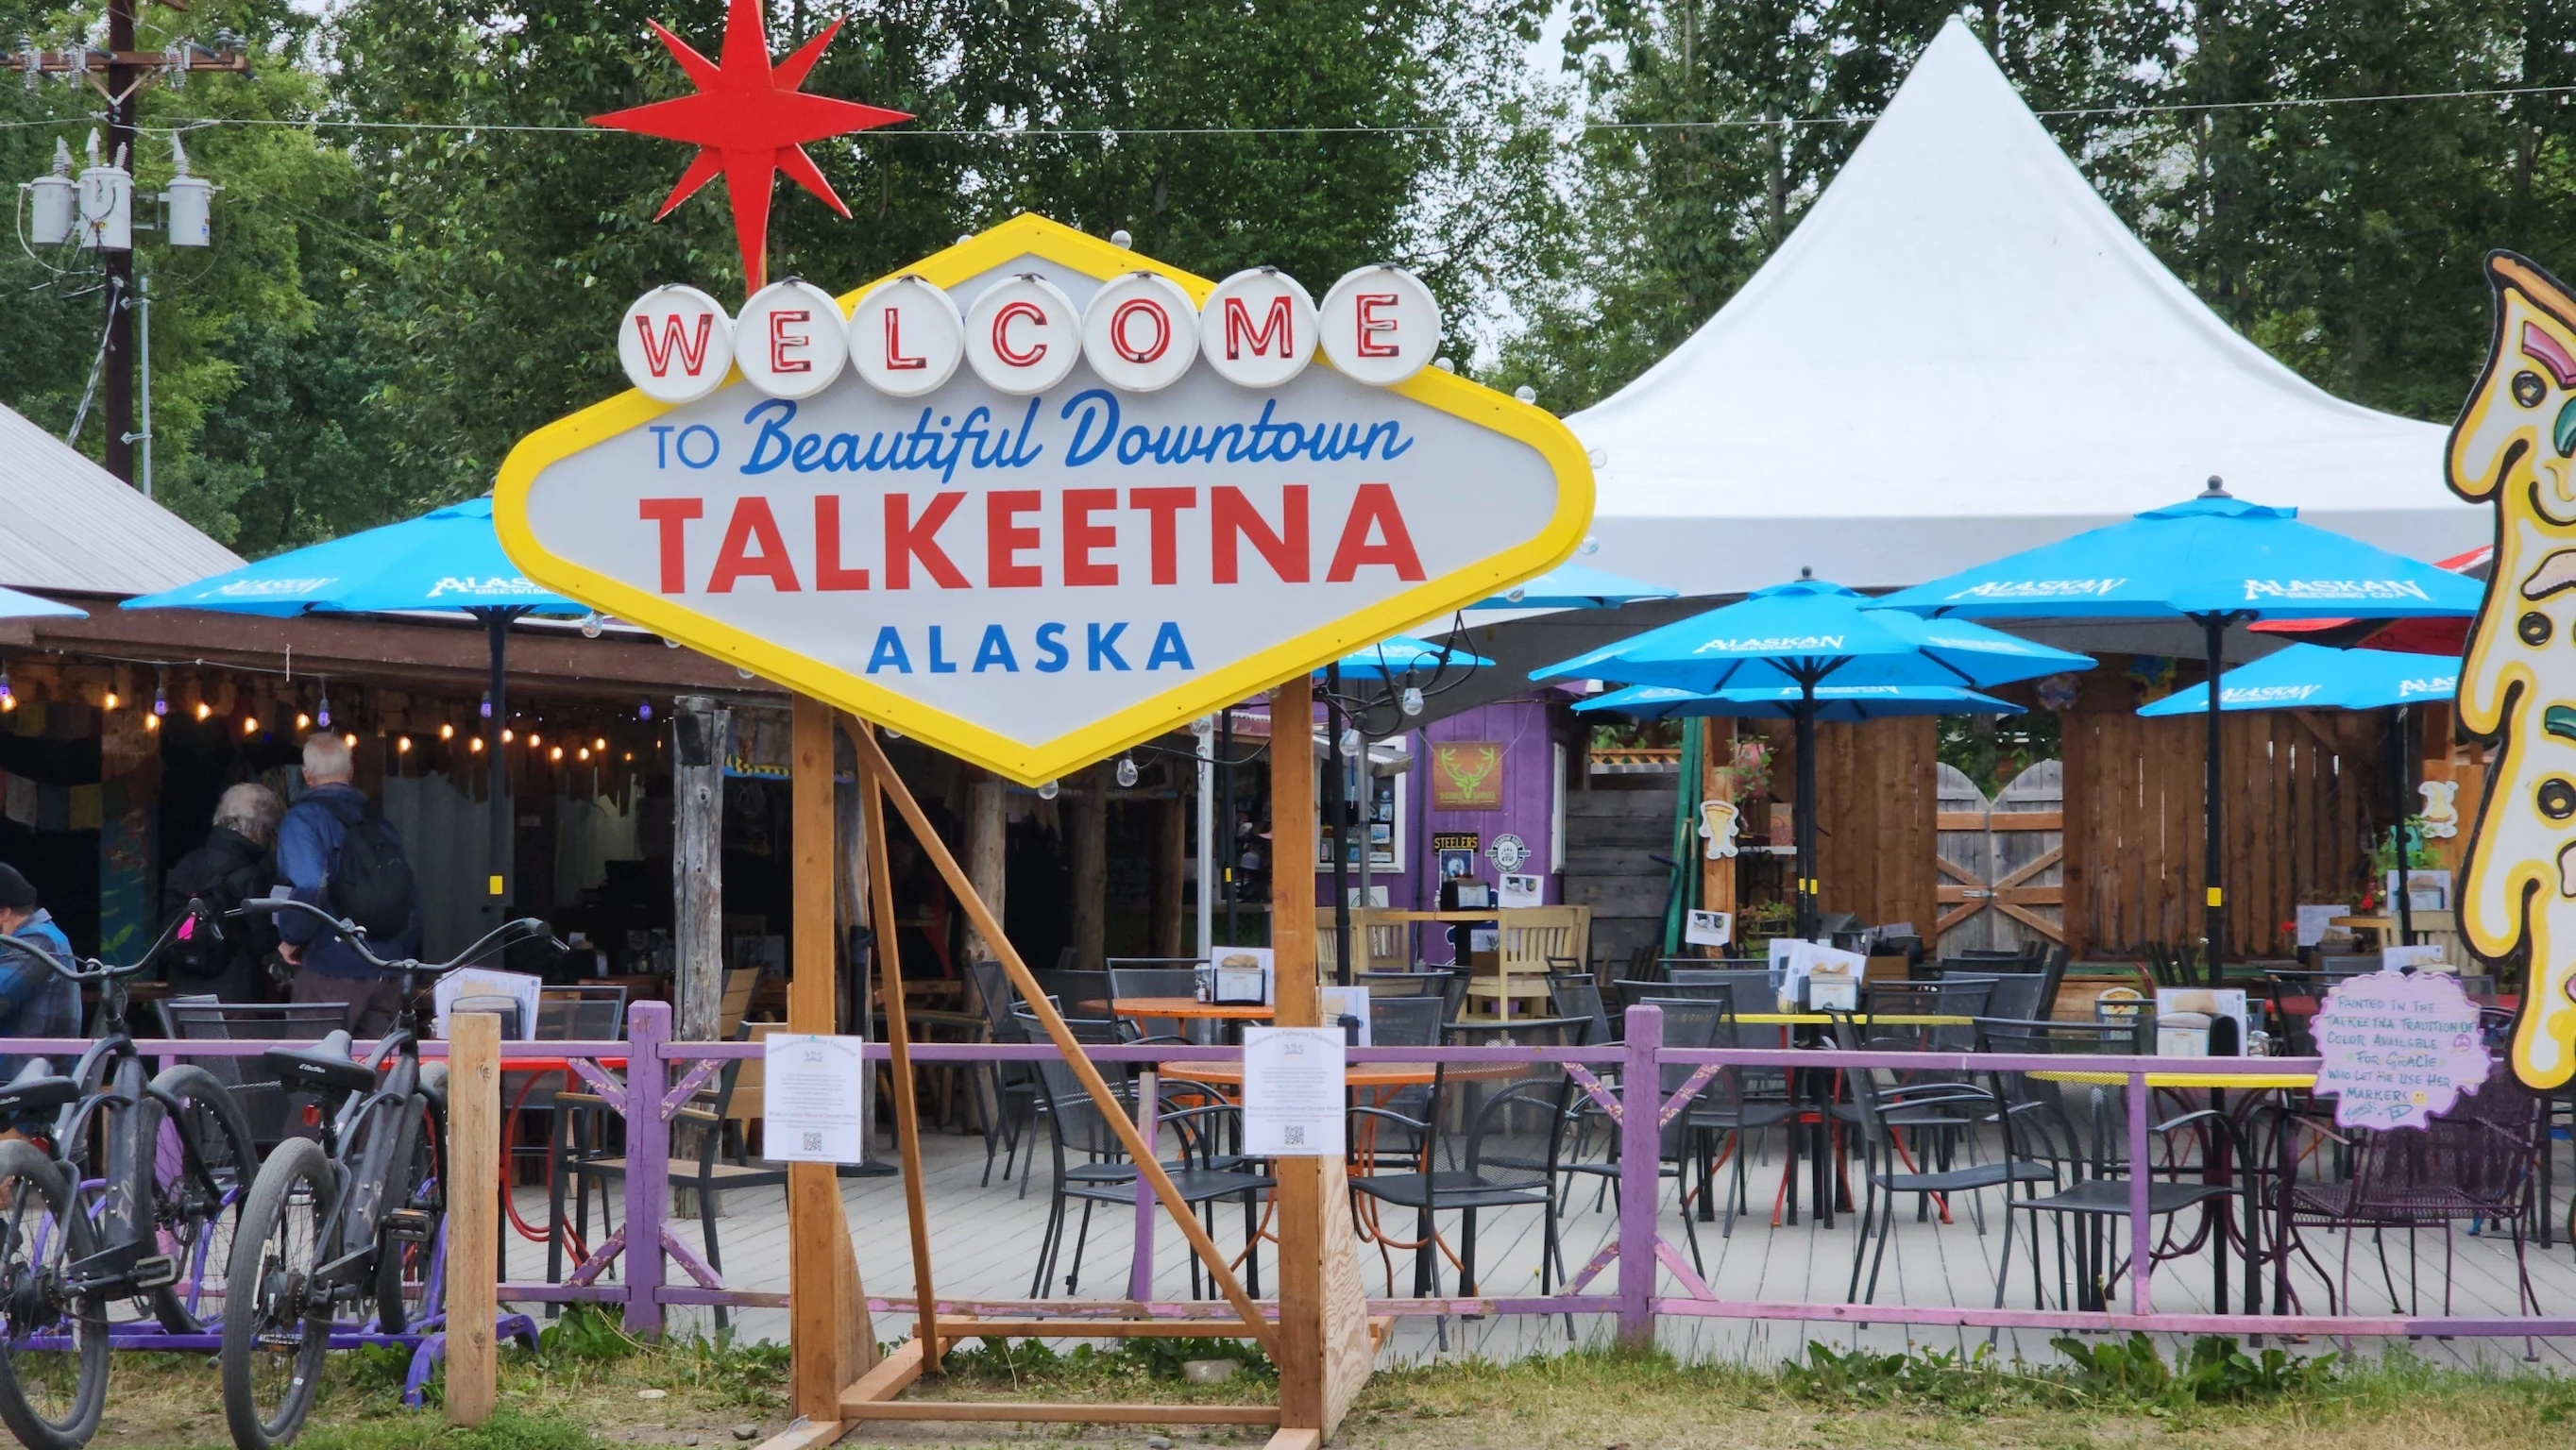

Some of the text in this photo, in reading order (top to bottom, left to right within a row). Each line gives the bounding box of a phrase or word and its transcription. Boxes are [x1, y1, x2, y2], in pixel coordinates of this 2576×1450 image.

[636, 294, 1399, 378] WELCOME
[650, 389, 1415, 484] TO Beautiful Downtown
[639, 483, 1426, 595] TALKEETNA
[427, 577, 536, 598] ALAS
[1943, 579, 2129, 599] ALASKAN
[2245, 580, 2431, 601] ALASKAN
[866, 620, 1195, 675] ALASKA
[1692, 635, 1844, 654] ALASKAN
[2399, 679, 2456, 698] ALAS
[1434, 836, 1478, 849] STEELERS
[2337, 995, 2385, 1010] PAINTED
[2412, 1001, 2435, 1013] THE
[2327, 1032, 2365, 1047] COLOR
[2356, 1051, 2380, 1066] FOR
[2399, 1073, 2424, 1085] USE
